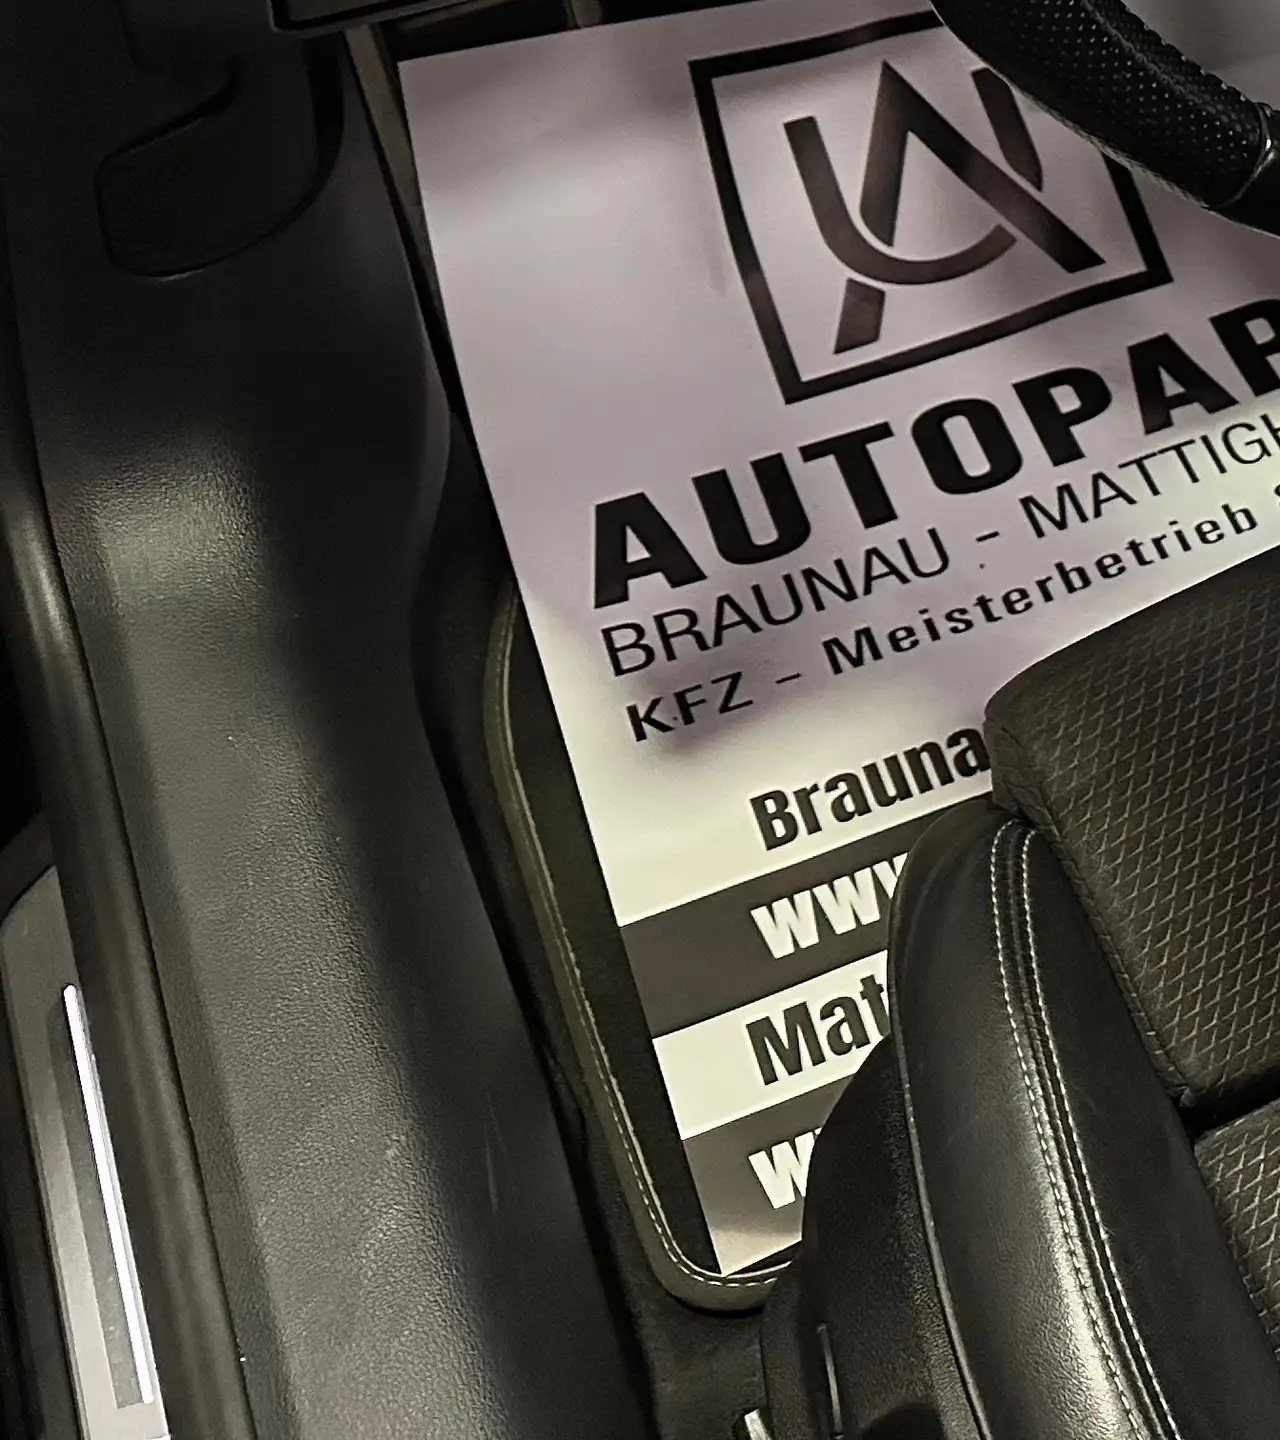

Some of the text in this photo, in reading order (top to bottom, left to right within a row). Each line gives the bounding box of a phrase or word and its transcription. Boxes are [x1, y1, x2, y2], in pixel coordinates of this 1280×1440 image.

[601, 527, 951, 677] BRAUNAU
[626, 671, 754, 742] KFZ
[822, 503, 1258, 676] Meisterbetrieb
